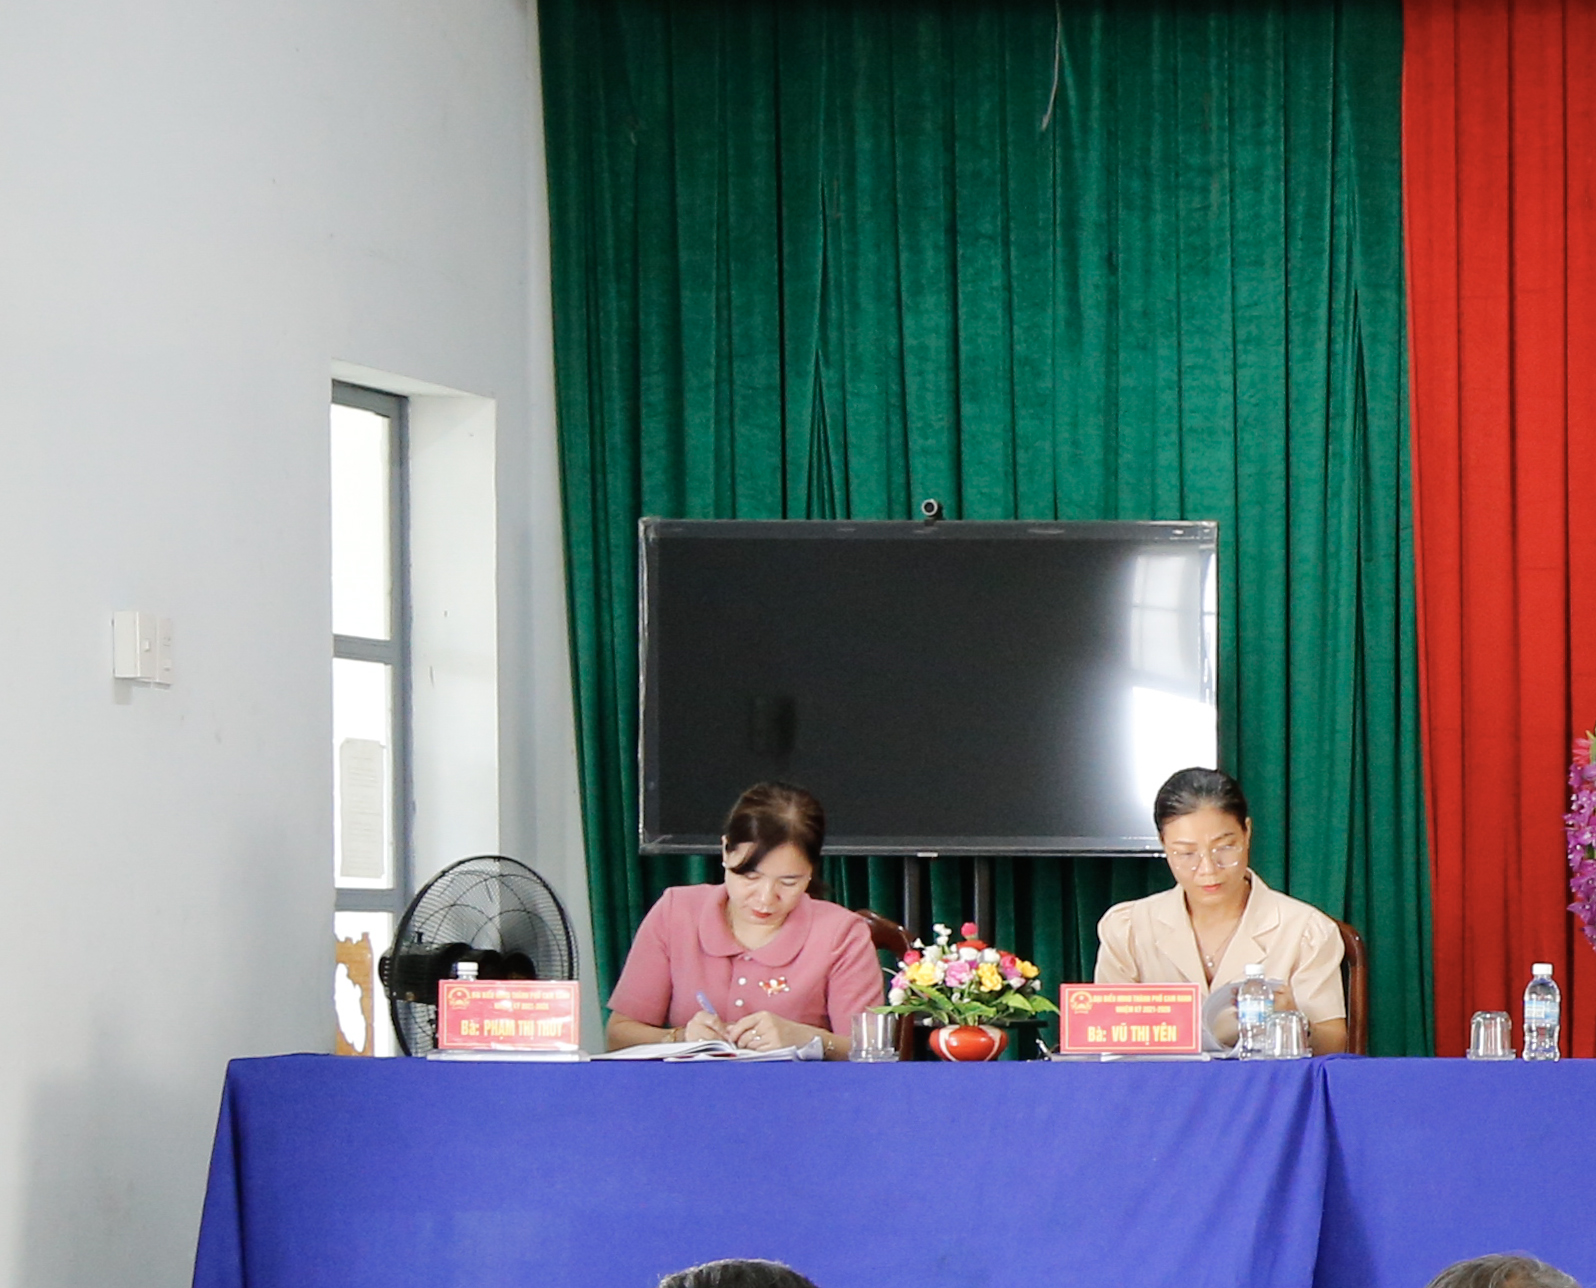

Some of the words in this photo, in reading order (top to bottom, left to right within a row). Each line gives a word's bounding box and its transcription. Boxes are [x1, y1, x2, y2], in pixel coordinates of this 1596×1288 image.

[461, 1019, 479, 1036] Bà:
[484, 1019, 516, 1040] PHẠM
[518, 1020, 535, 1040] THỊ
[1088, 1025, 1107, 1042] Bà:
[1111, 1022, 1127, 1042] VŨ
[1130, 1025, 1150, 1046] THỊ
